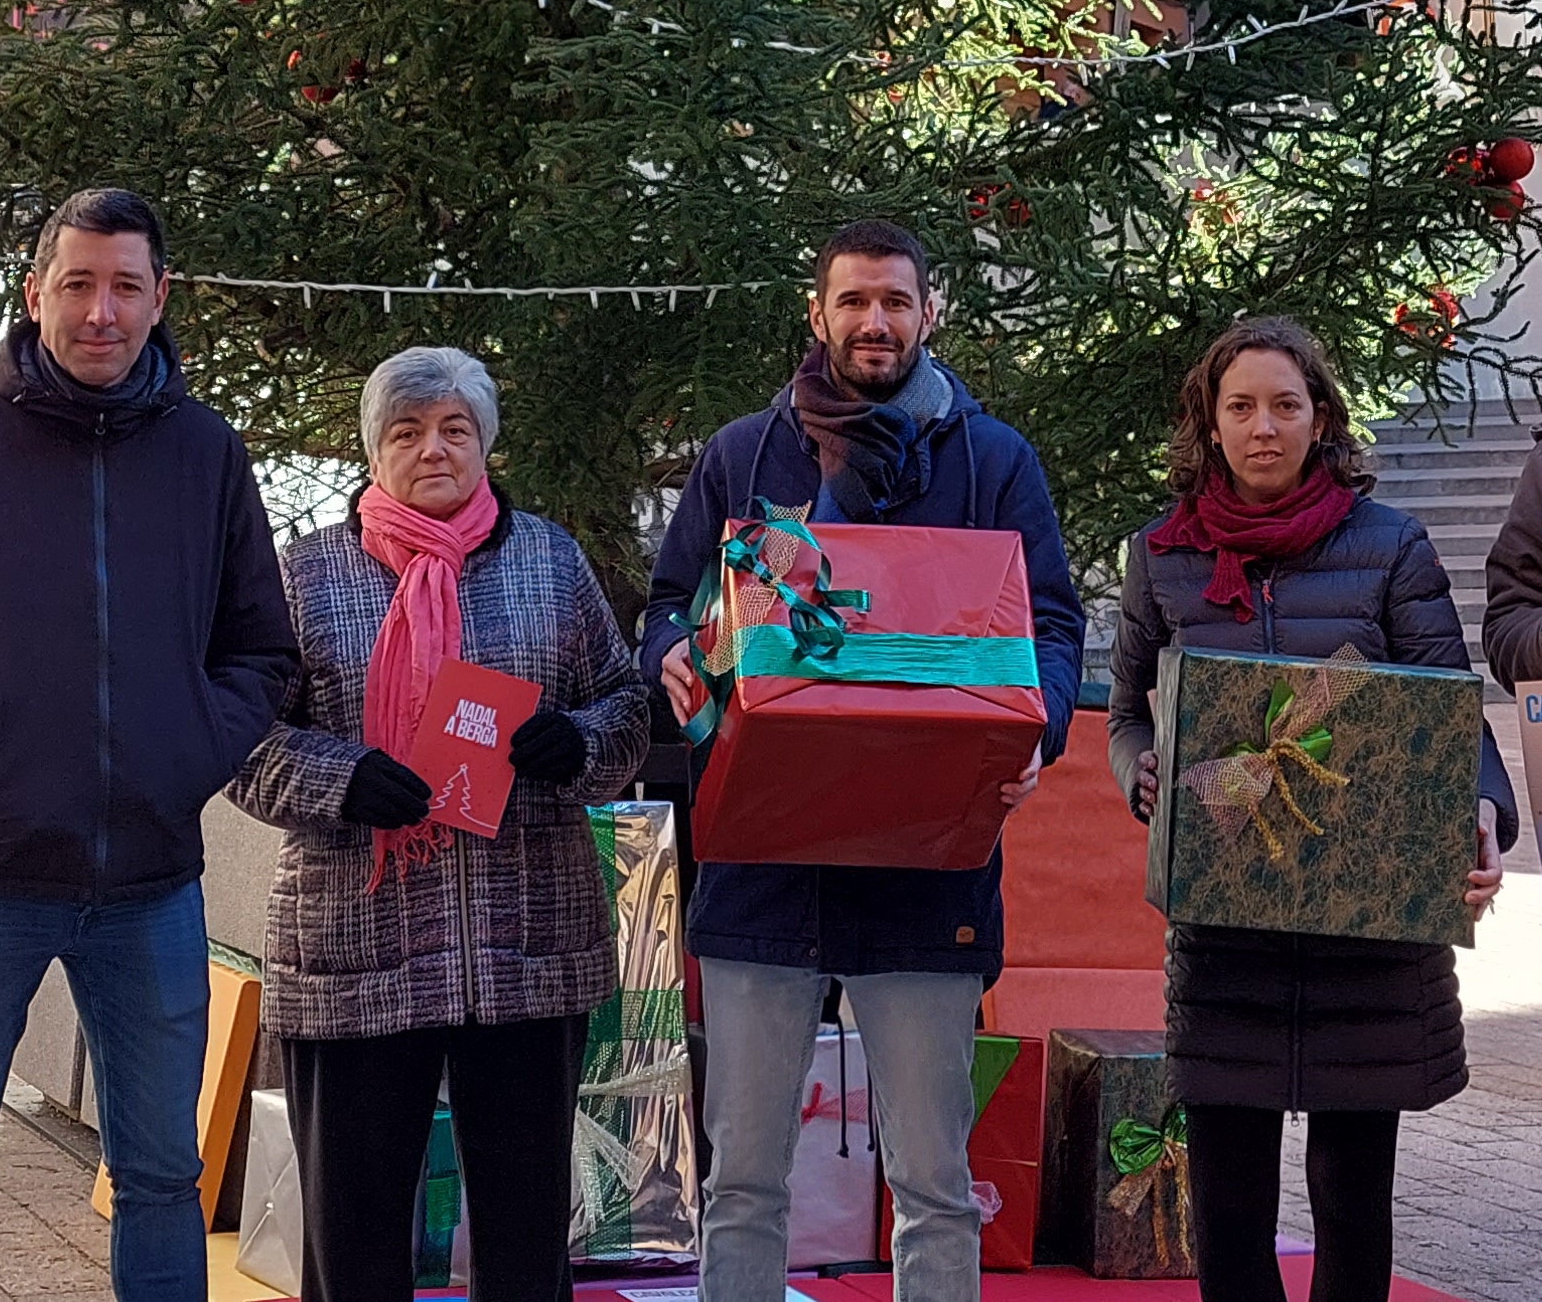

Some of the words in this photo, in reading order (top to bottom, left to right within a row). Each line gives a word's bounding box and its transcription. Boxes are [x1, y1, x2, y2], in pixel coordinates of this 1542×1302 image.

[455, 698, 498, 730] NADAL
[443, 716, 456, 736] A
[456, 719, 499, 749] BERGA
